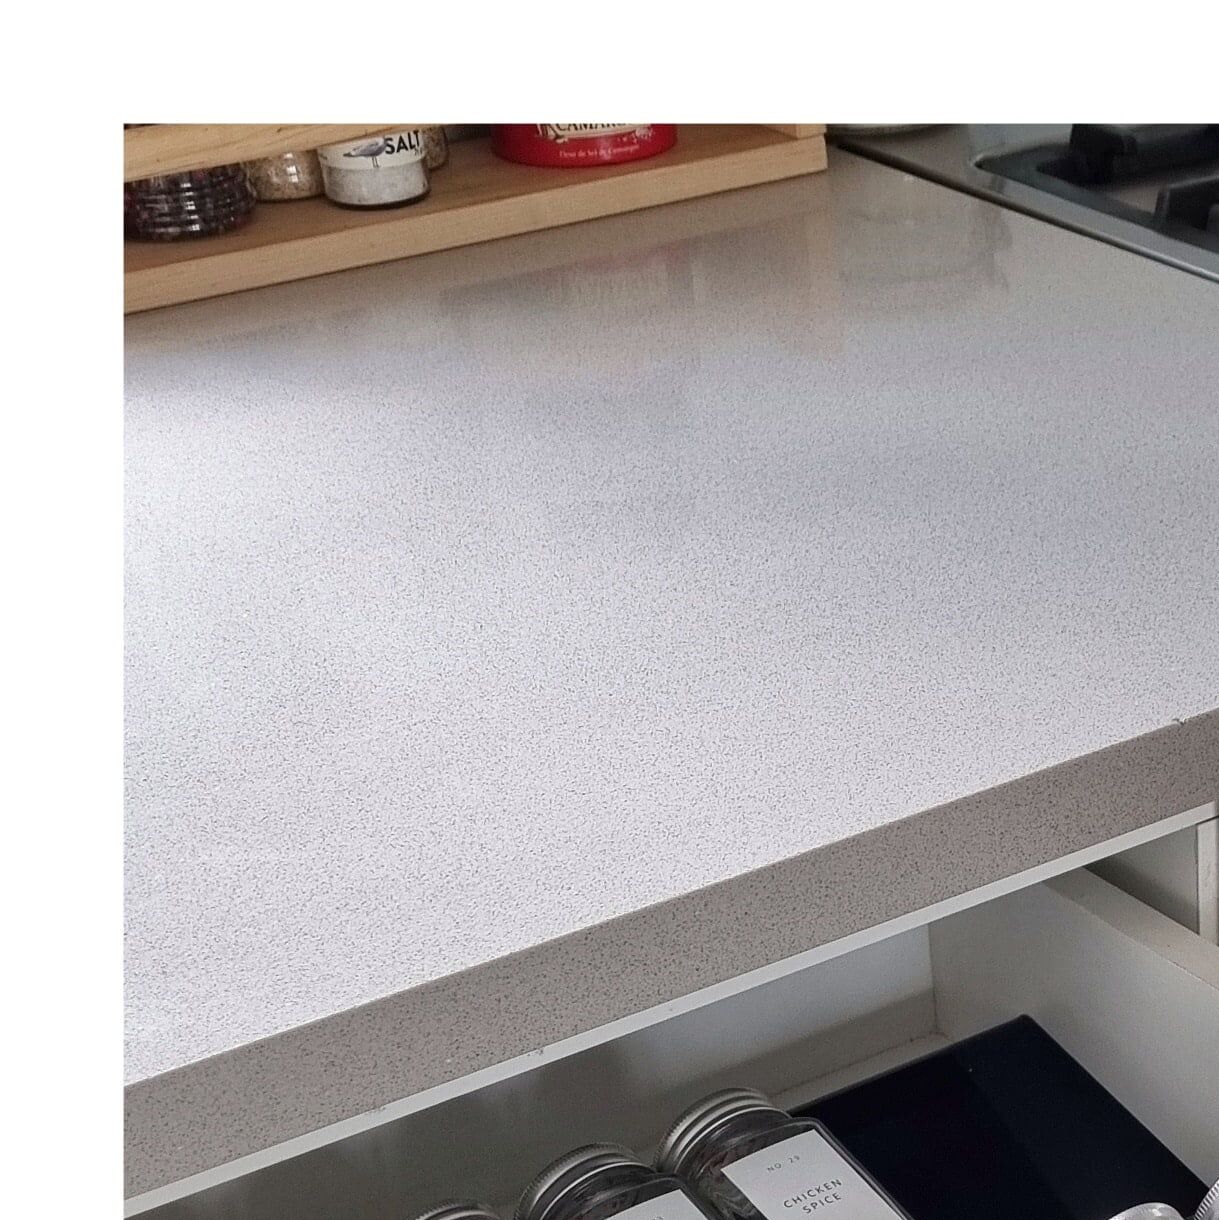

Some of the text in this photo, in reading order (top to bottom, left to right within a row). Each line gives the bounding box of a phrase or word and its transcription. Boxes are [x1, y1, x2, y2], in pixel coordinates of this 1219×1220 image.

[385, 130, 420, 154] SALT
[783, 1178, 843, 1209] CHICKEN
[803, 1192, 842, 1214] SPICE
